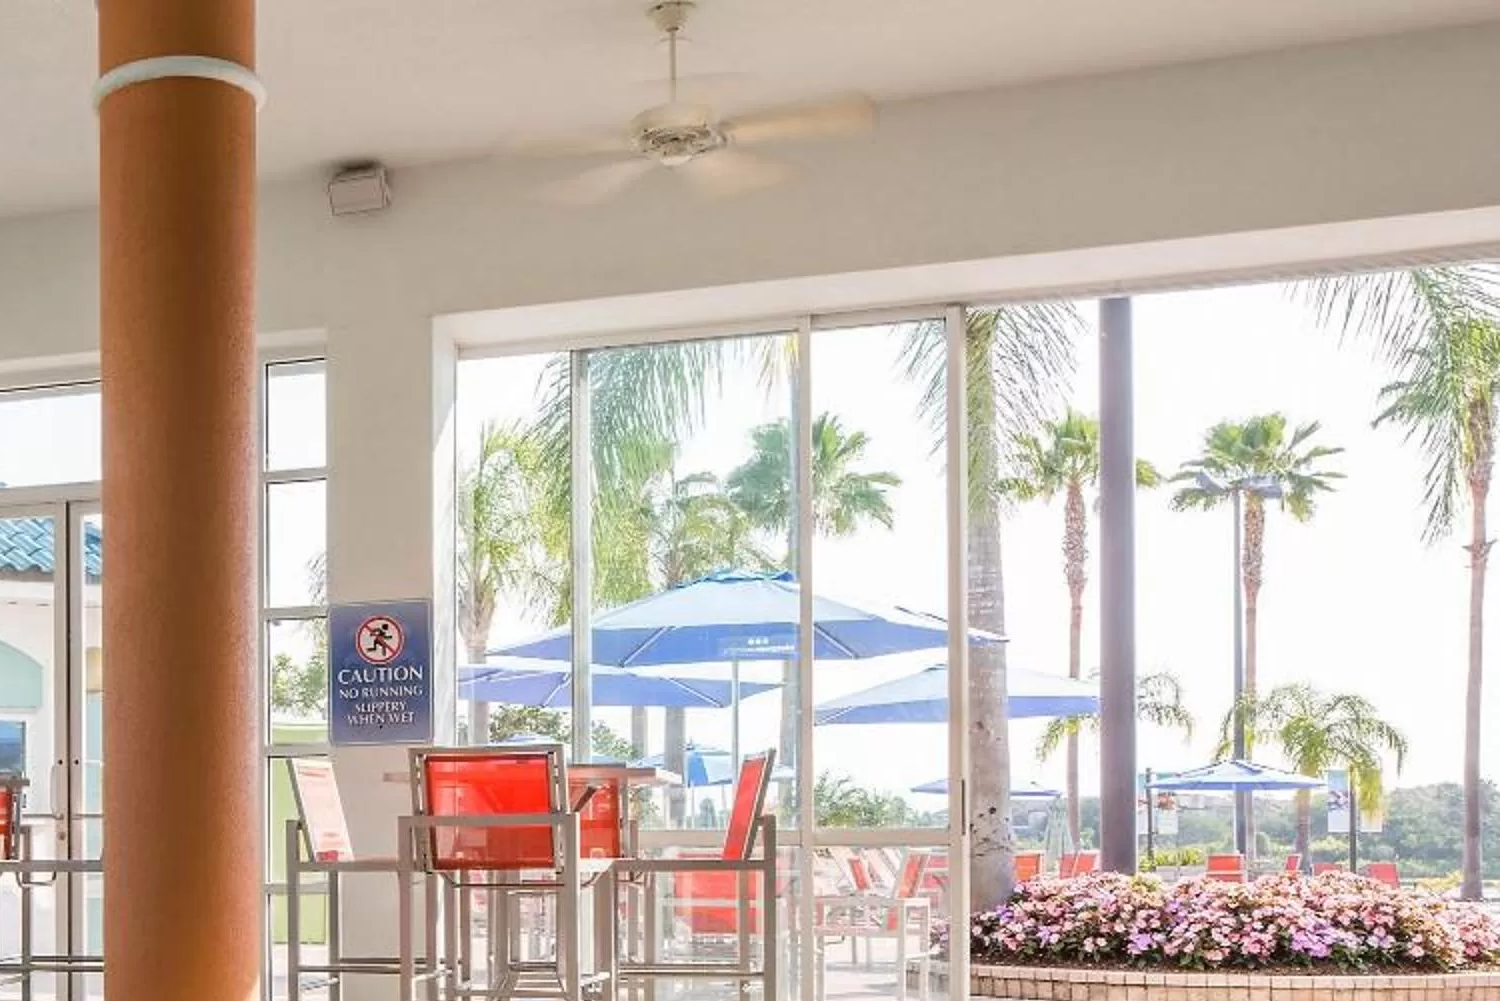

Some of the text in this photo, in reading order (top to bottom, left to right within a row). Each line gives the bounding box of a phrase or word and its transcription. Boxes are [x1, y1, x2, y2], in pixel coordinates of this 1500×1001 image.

[338, 665, 423, 685] CAUTION
[339, 685, 423, 699] NO RUNNING
[355, 701, 407, 713] SLIPPERY
[347, 711, 415, 726] WHEN WET
